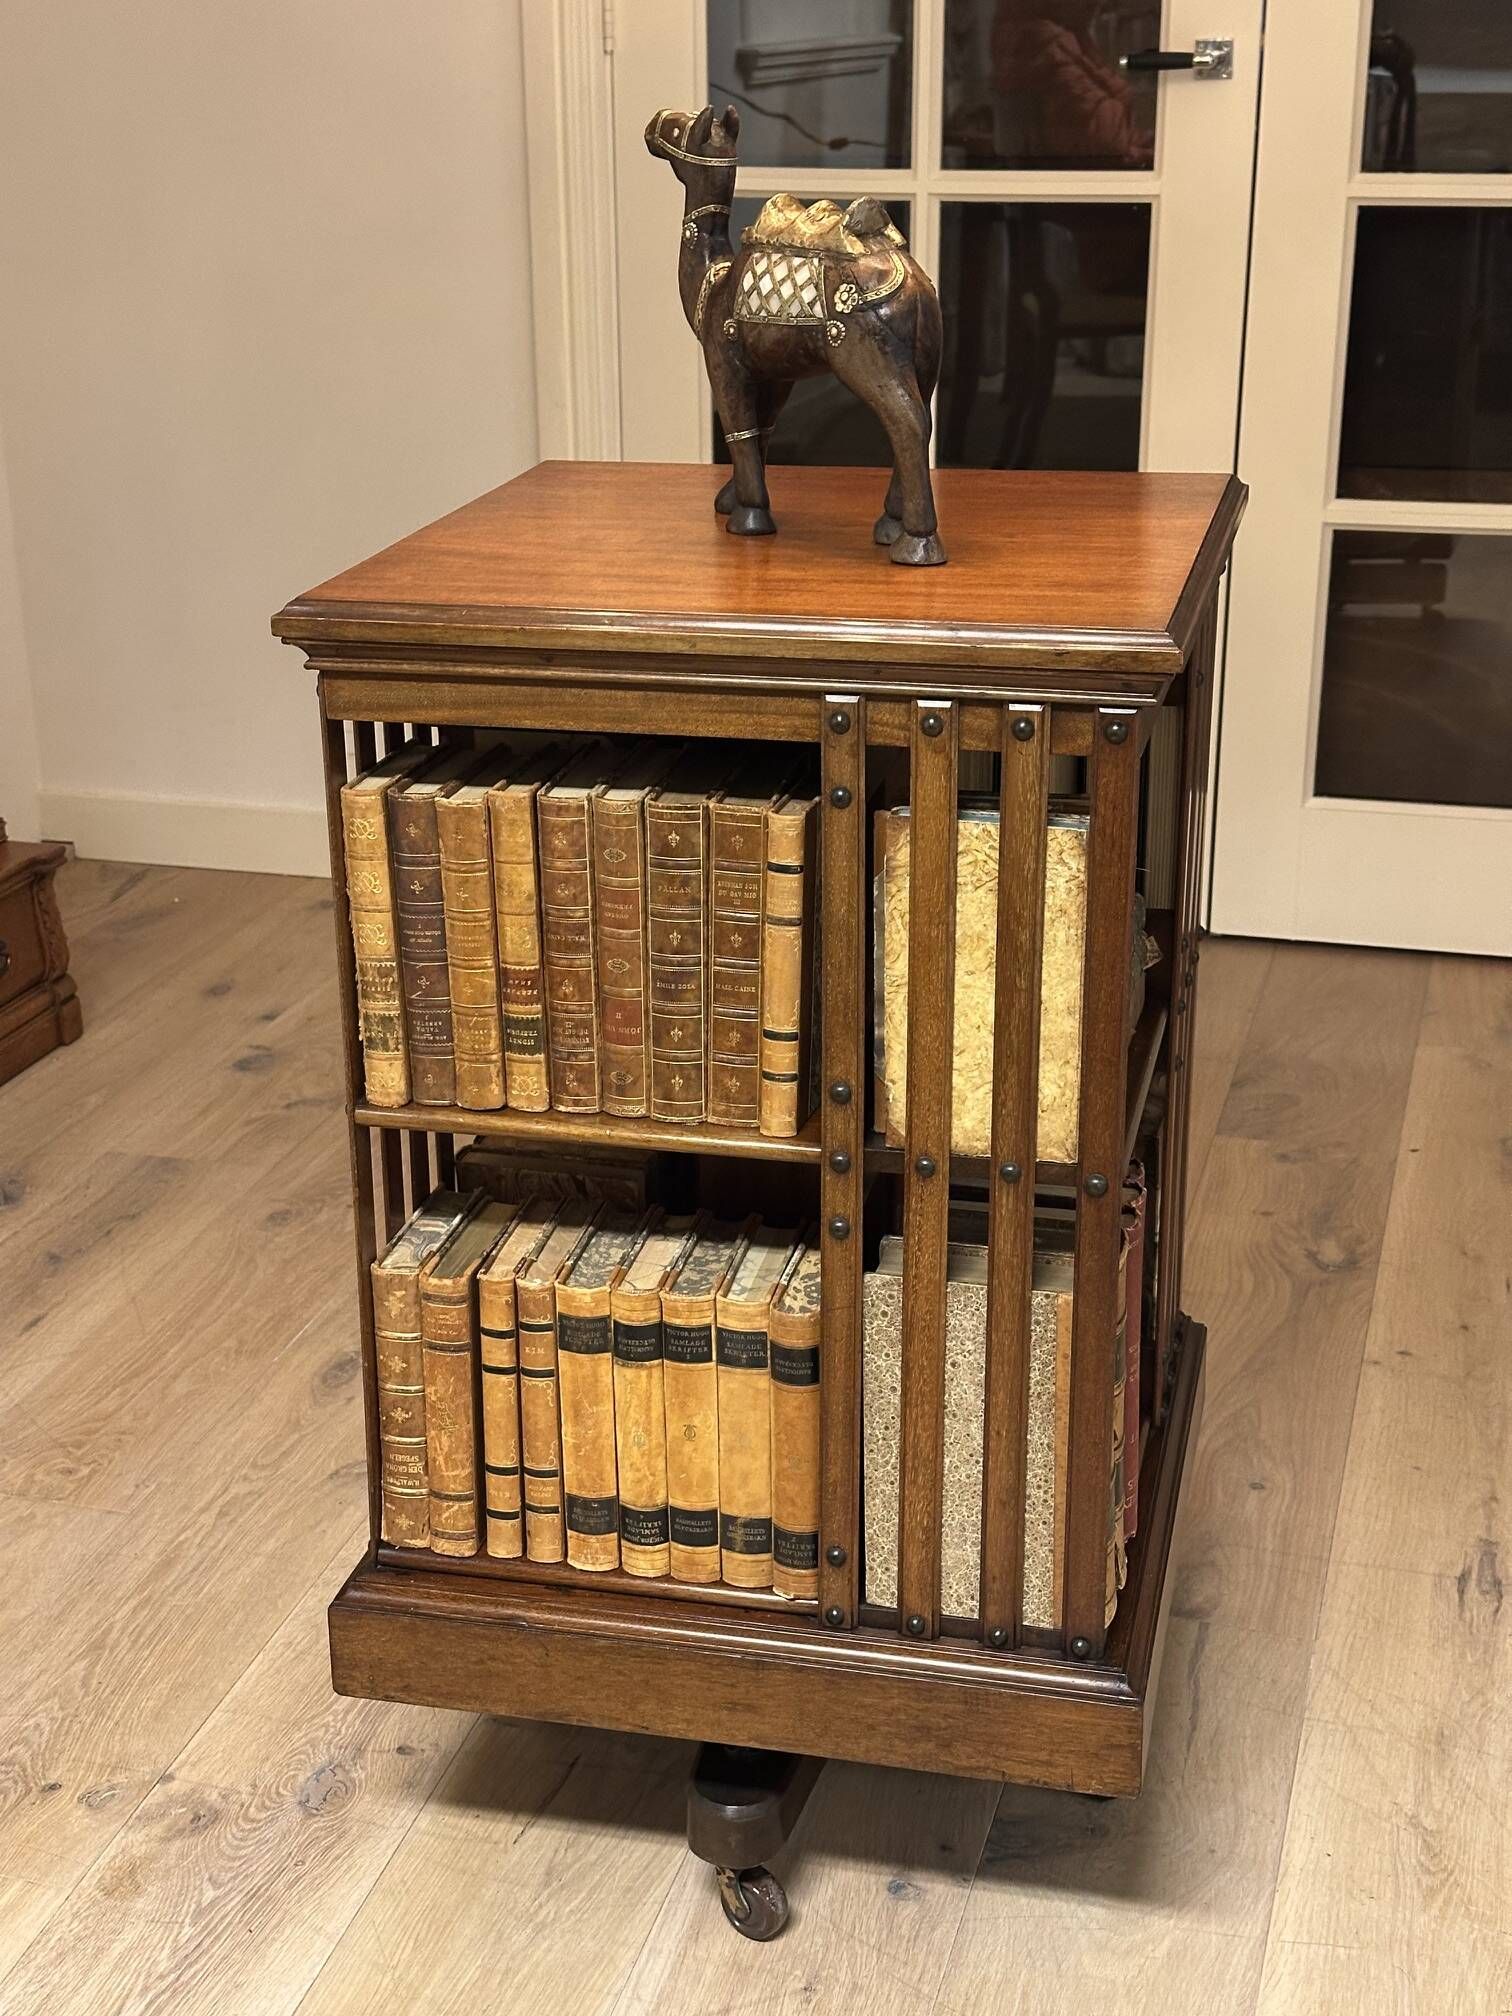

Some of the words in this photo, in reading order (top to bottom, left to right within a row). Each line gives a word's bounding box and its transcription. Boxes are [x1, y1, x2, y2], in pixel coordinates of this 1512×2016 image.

[670, 1337, 706, 1347] SAMLADE
[524, 1346, 545, 1355] KIM
[389, 1453, 420, 1463] SPEGELN
[407, 1465, 424, 1474] DEN
